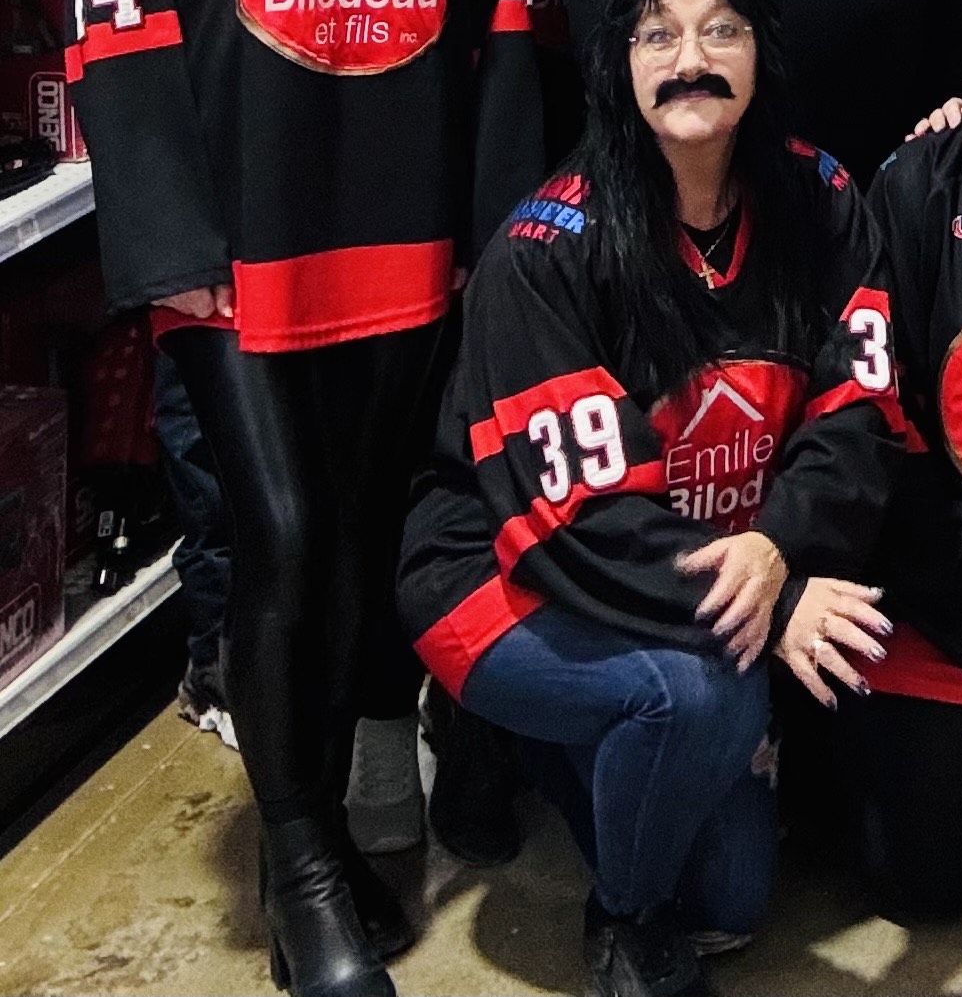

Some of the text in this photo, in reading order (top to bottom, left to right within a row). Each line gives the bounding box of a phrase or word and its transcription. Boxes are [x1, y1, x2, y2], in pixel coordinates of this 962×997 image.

[315, 17, 336, 45] et
[344, 14, 390, 45] fils
[527, 394, 628, 504] 39
[665, 429, 775, 484] Emile
